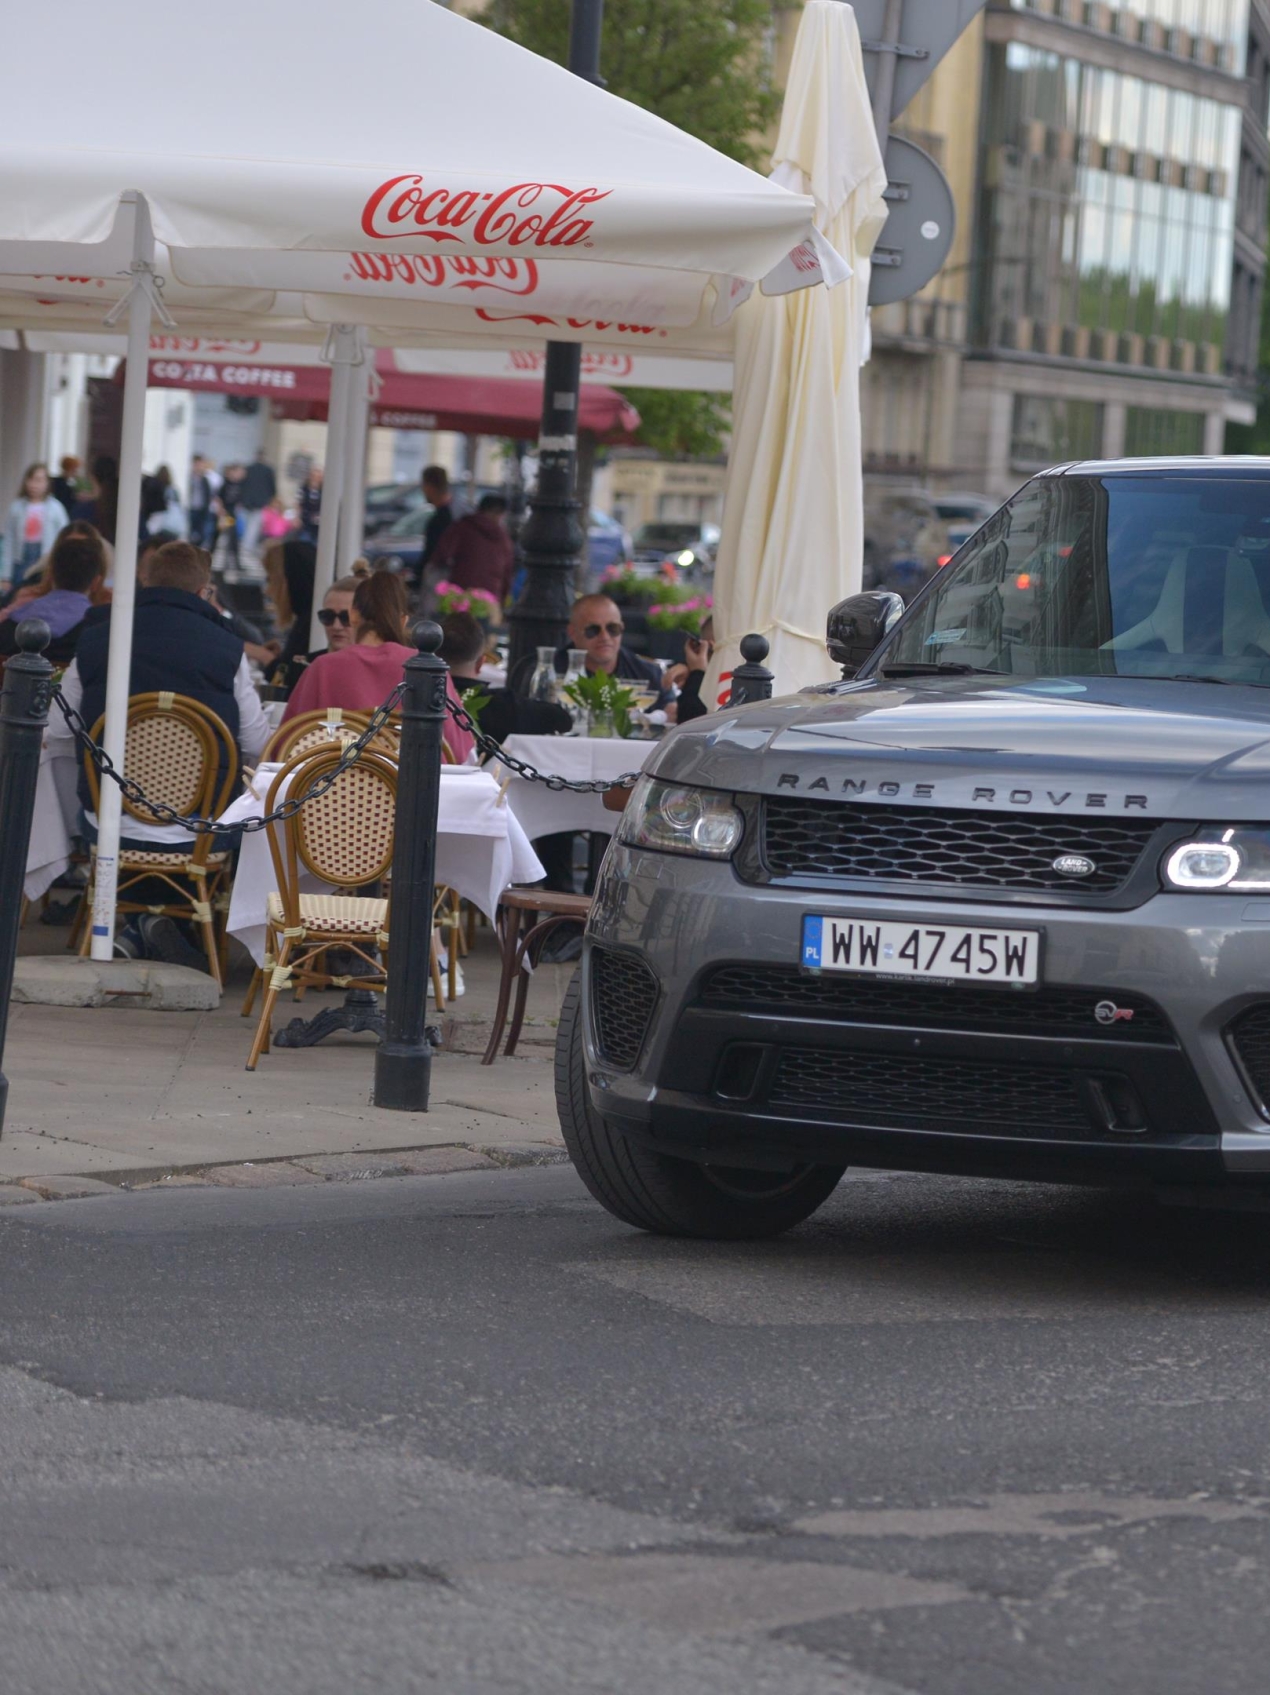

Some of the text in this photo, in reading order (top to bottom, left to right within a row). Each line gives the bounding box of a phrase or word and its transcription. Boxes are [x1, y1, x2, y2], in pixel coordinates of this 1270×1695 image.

[361, 175, 614, 246] Coca-Cola
[221, 366, 297, 389] COFFEE
[777, 773, 1148, 809] RANGE ROVER
[1061, 858, 1083, 866] LAND
[806, 947, 819, 959] PL
[832, 922, 1028, 977] WW 4745W
